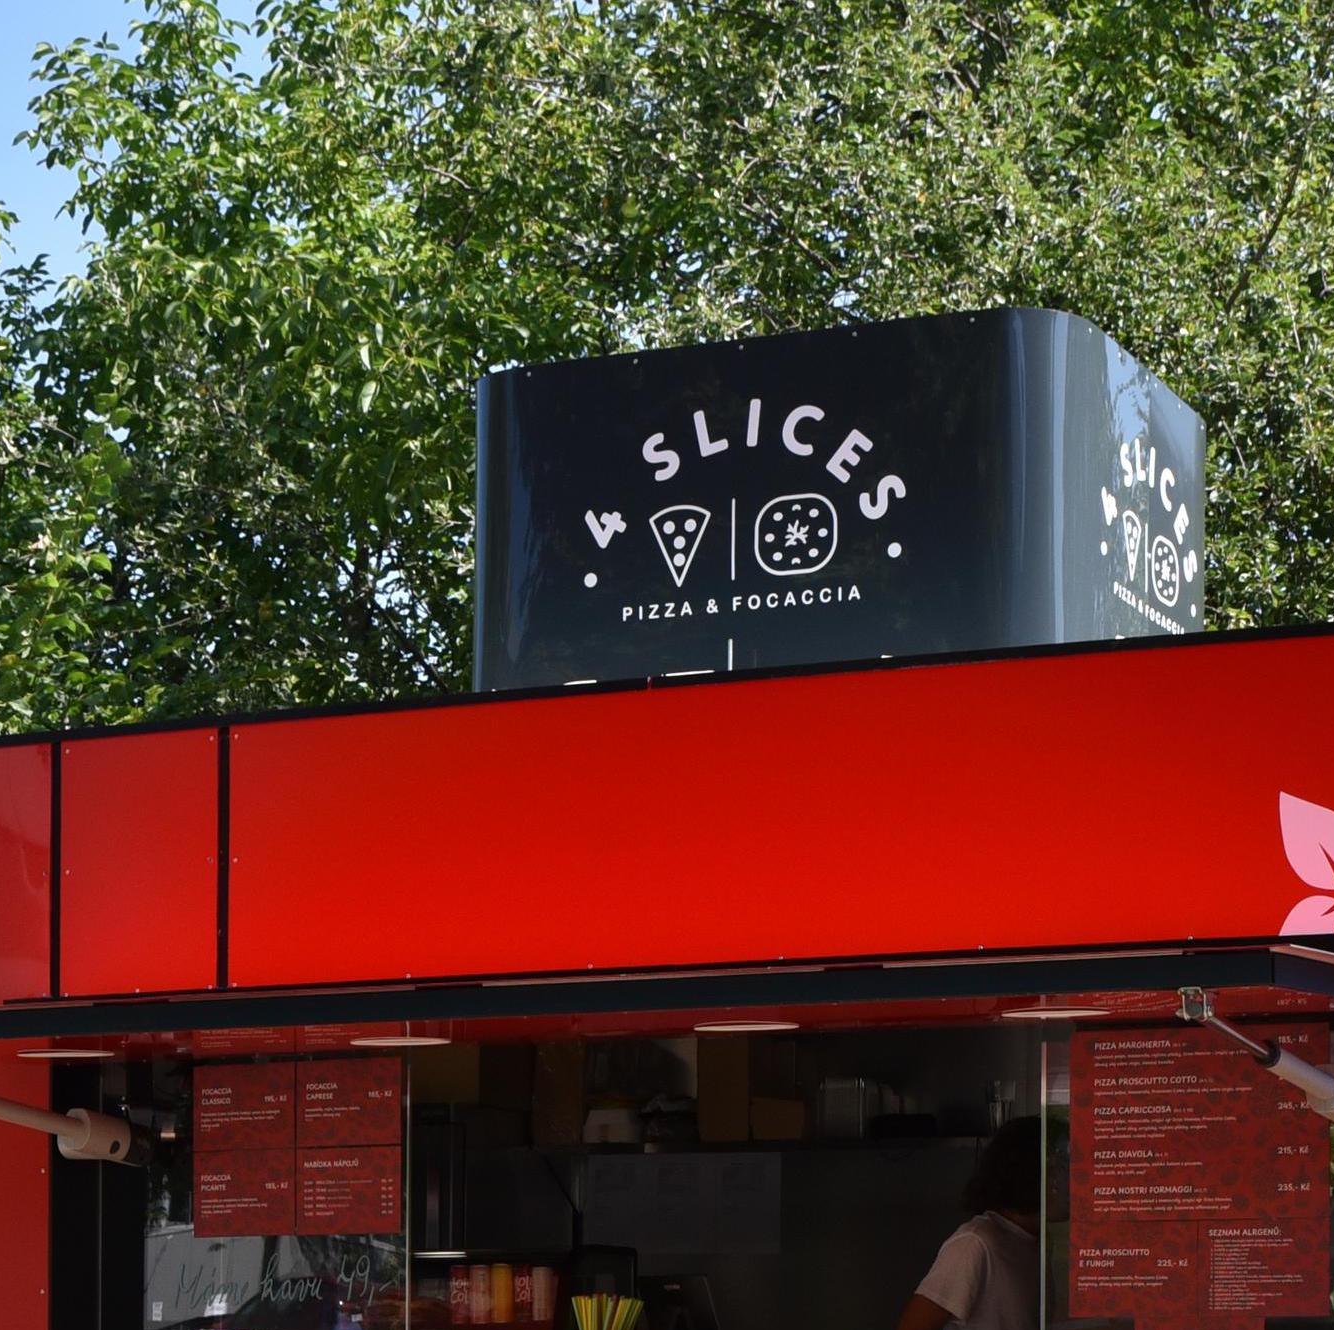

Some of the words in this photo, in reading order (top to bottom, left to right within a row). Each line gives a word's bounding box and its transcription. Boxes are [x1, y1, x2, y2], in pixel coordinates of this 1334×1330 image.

[584, 509, 627, 549] 4
[641, 398, 907, 520] SLICES
[1120, 438, 1198, 583] SLICES
[1113, 581, 1136, 608] PIZZA
[622, 600, 693, 622] PIZZA
[706, 599, 719, 614] &
[732, 584, 861, 612] FOCACCIA
[1094, 1042, 1116, 1050] PIZZA
[1118, 1040, 1171, 1049] MARGHERITA
[1094, 1079, 1116, 1087] PIZZA
[1118, 1076, 1168, 1085] PROSCIUTTO
[1170, 1075, 1197, 1084] COTTO
[202, 1088, 232, 1096] FOCACCIA
[306, 1083, 338, 1091] FOCACCIA
[202, 1098, 231, 1106] CLASSICO
[306, 1093, 334, 1101] CAPRESE
[1094, 1107, 1117, 1116] PIZZA
[1118, 1105, 1171, 1115] CAPRICCIOSA
[1094, 1151, 1116, 1160] PIZZA
[1118, 1149, 1153, 1159] DIAVOLA
[201, 1184, 227, 1192] PICANTE
[1094, 1187, 1116, 1196] PIZZA
[1118, 1186, 1147, 1195] NOSTRI
[1149, 1186, 1193, 1195] FORMAGGI
[1208, 1229, 1241, 1238] SEZNAM
[1079, 1249, 1100, 1257] PIZZA
[1102, 1248, 1150, 1257] PROSCIUTTO
[1085, 1259, 1114, 1268] FUNGHI
